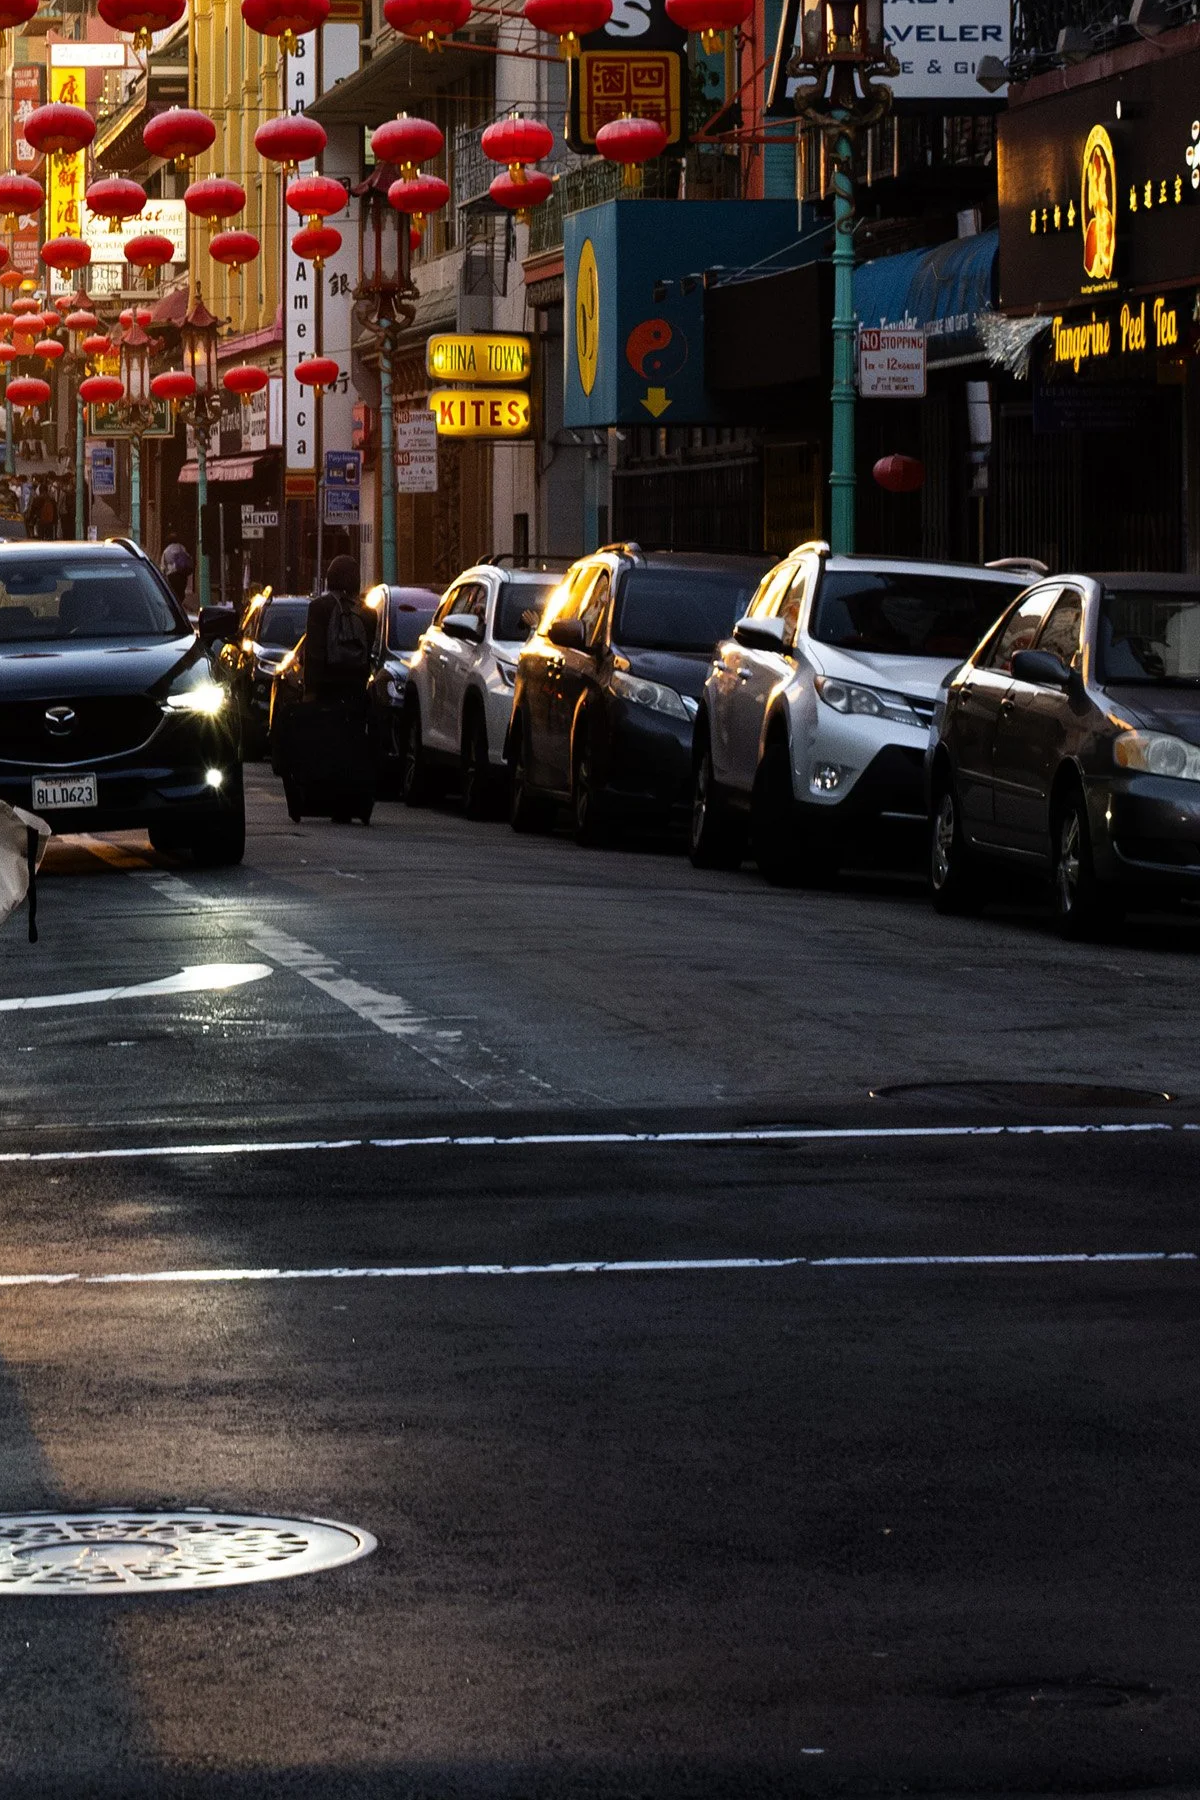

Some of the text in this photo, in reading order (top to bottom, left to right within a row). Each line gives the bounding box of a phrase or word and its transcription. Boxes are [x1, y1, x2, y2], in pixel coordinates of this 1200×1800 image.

[884, 25, 1003, 42] VELER
[293, 38, 306, 114] Ban
[862, 332, 923, 349] NO STOPPING
[1053, 297, 1178, 373] Tangerine Peel Tea
[436, 344, 524, 372] CHINA TOWN
[440, 401, 520, 427] KITES
[244, 514, 276, 524] MENTO
